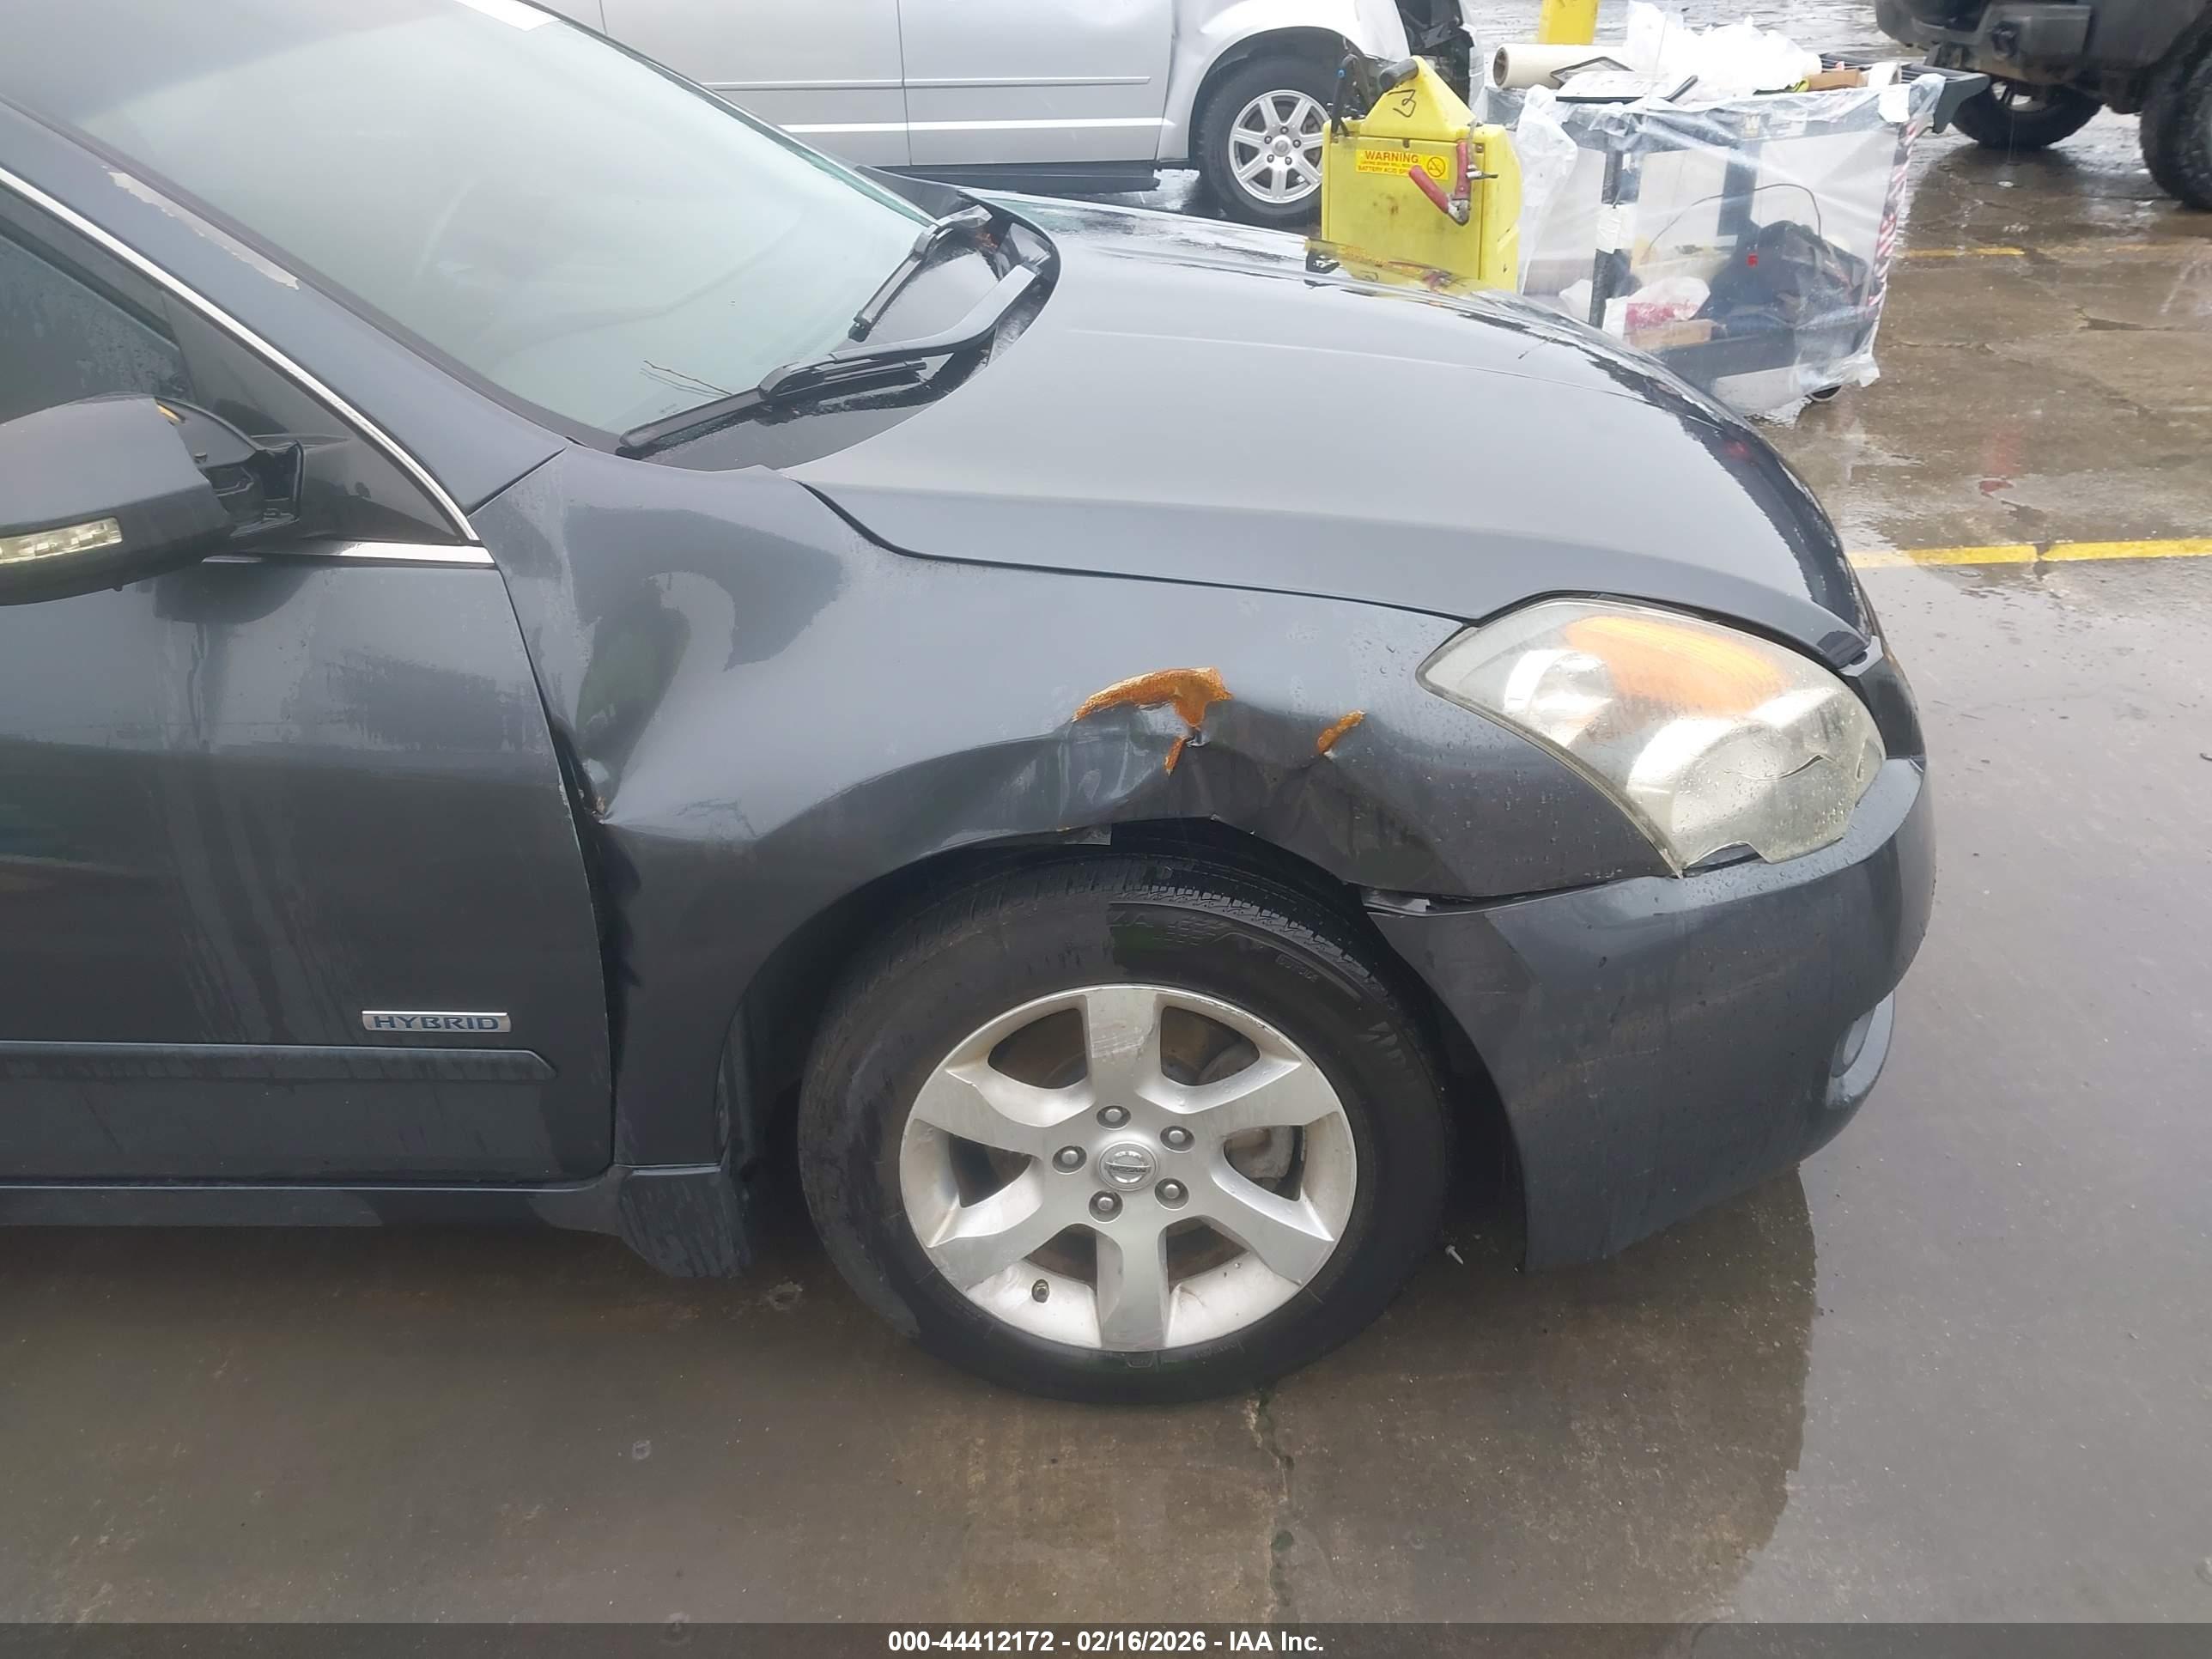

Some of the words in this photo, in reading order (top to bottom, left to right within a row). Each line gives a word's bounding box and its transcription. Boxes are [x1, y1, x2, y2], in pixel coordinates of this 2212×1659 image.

[1387, 89, 1416, 118] 3
[1364, 150, 1419, 163] WARNING
[374, 1016, 499, 1030] HYBRID
